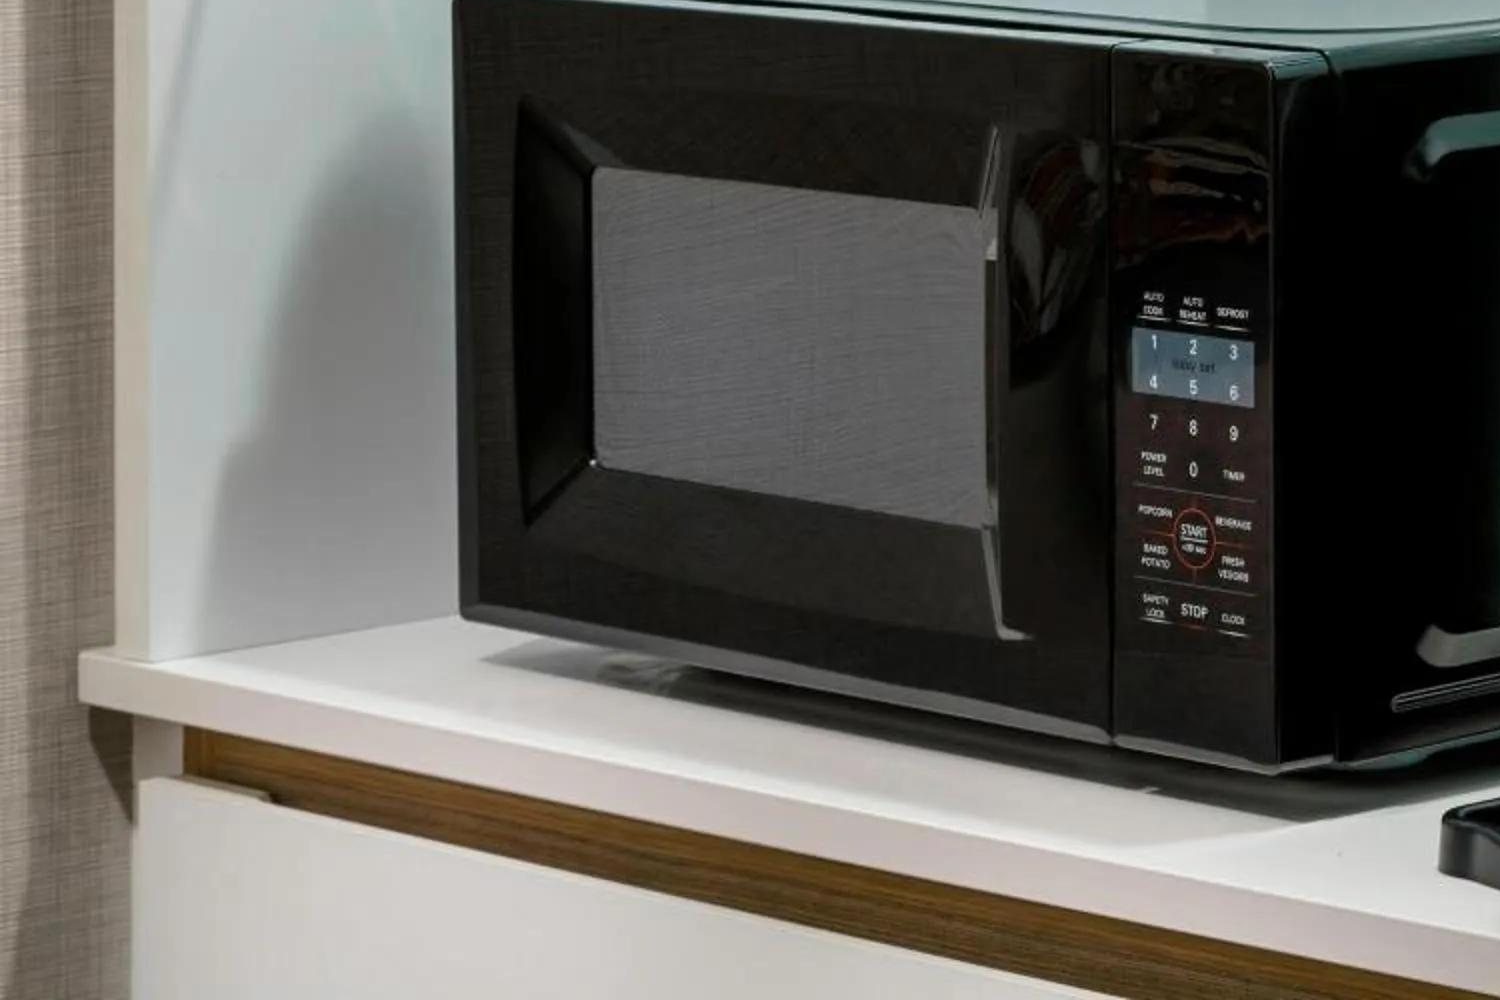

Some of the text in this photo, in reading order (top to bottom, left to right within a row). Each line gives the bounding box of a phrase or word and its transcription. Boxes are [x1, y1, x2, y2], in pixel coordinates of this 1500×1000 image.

[1216, 306, 1249, 319] DEFROST
[1151, 333, 1239, 361] 1 2 3
[1149, 375, 1239, 401] 4 5 6
[1149, 413, 1239, 442] 7 8 9
[1143, 465, 1165, 477] LEVEL
[1188, 461, 1199, 478] 0
[1222, 469, 1245, 482] TIMER
[1138, 504, 1173, 518] POPCORN
[1181, 523, 1207, 538] START
[1141, 556, 1171, 570] POTATO
[1180, 602, 1209, 619] STOP
[1221, 613, 1245, 626] CLOCK
